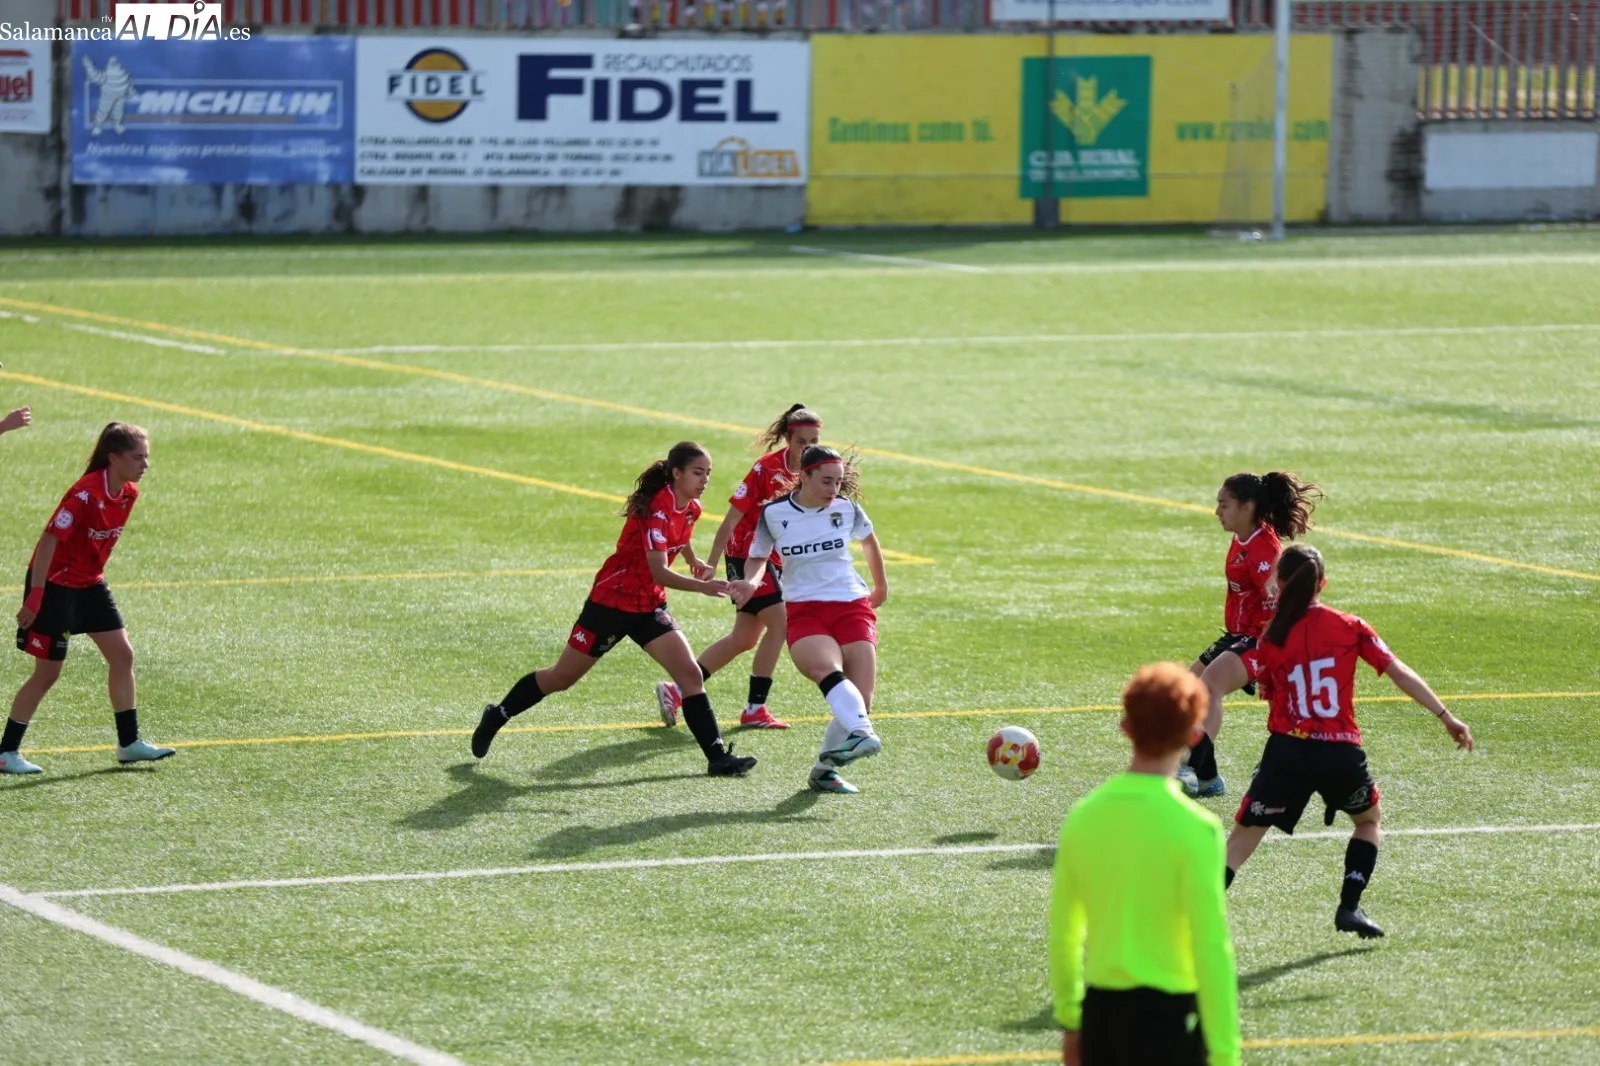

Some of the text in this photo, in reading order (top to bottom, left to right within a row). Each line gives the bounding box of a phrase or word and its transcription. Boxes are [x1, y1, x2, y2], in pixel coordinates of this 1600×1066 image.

[602, 53, 753, 73] RECAUCHUTADOS
[386, 74, 485, 97] FIDEL
[516, 53, 780, 123] FIDEL
[136, 90, 334, 115] MICHELIN
[781, 538, 845, 557] correa
[1286, 656, 1340, 719] 15
